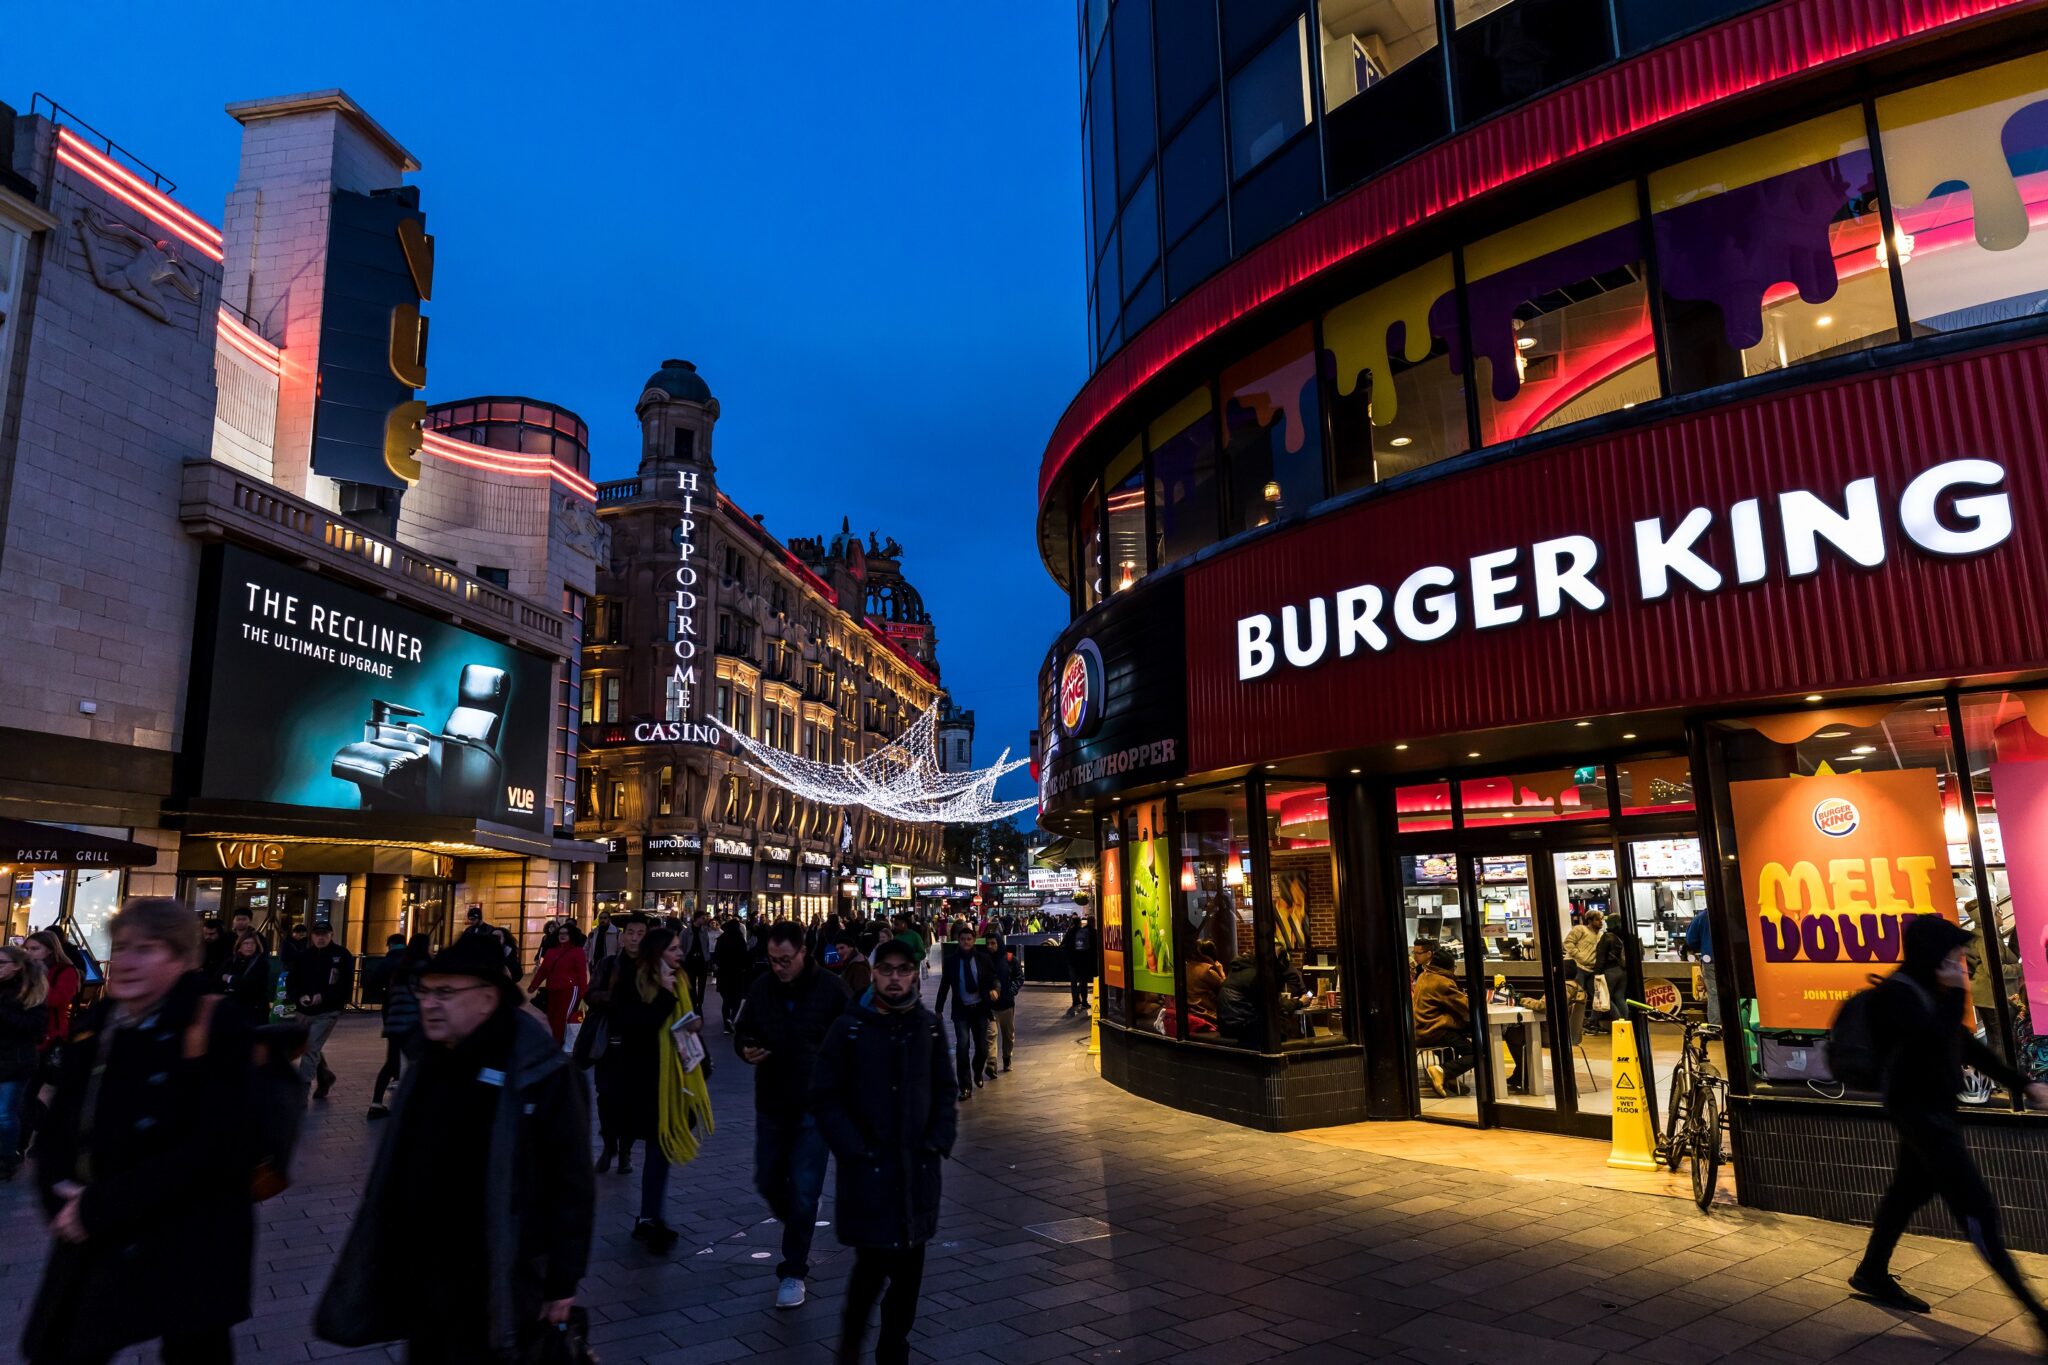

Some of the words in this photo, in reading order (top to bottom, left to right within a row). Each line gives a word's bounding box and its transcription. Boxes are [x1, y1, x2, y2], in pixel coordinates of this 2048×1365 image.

[1236, 533, 1607, 683] BURGER
[1633, 457, 2016, 601] KING
[673, 470, 699, 709] HIPPODROME
[246, 582, 299, 625] THE
[310, 604, 424, 664] RECLINER
[242, 623, 270, 648] THE
[273, 633, 337, 665] ULTIMATE
[340, 650, 395, 680] UPGRADE
[634, 722, 720, 745] CASINO
[1059, 770, 1071, 792] OF
[1072, 761, 1093, 786] THE
[1093, 738, 1176, 779] WHOPPER
[1818, 804, 1851, 821] BURGER
[1820, 811, 1854, 829] KING
[649, 839, 702, 849] HIPPODROME
[17, 849, 59, 862] PASTA
[75, 849, 110, 862] GRILL
[913, 876, 948, 885] CASINO
[1757, 856, 1937, 917] MELT
[1645, 985, 1673, 998] URGER
[1804, 989, 1827, 1000] JOIN
[1828, 990, 1849, 1001] THE
